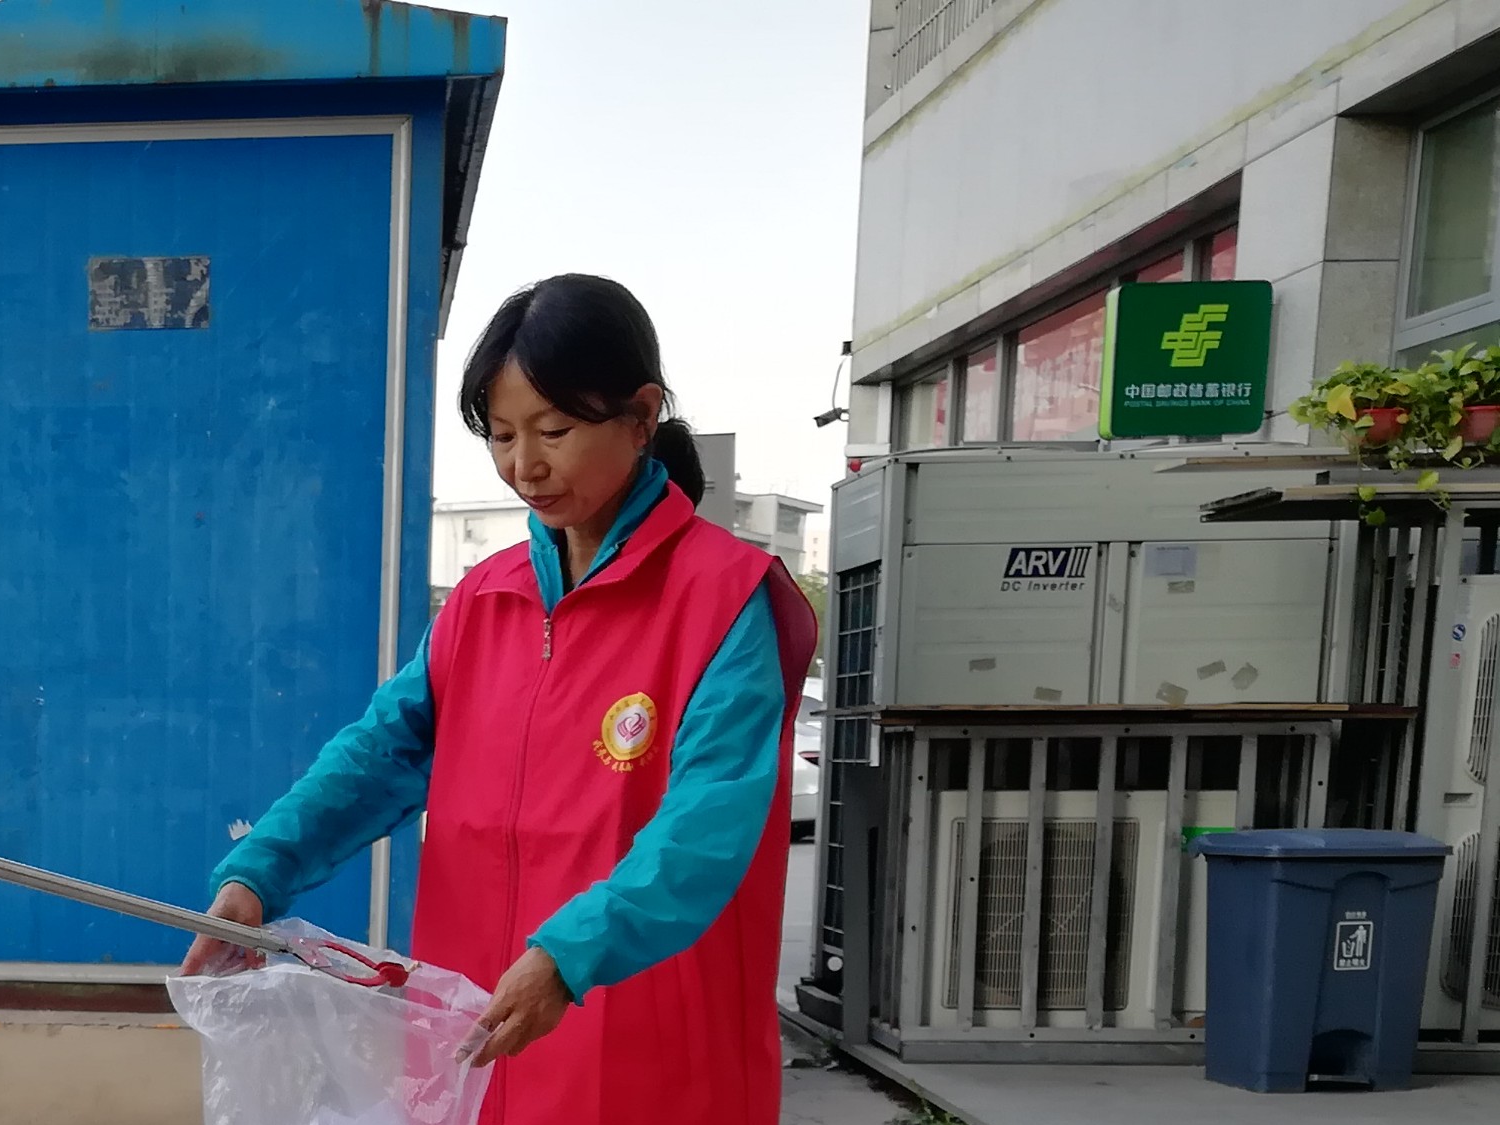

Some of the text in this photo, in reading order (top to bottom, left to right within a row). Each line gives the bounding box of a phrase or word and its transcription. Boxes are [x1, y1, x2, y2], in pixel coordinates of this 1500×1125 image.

[1124, 383, 1252, 398] 中国邮政储蓄银行
[1000, 581, 1086, 592] DC Inverter
